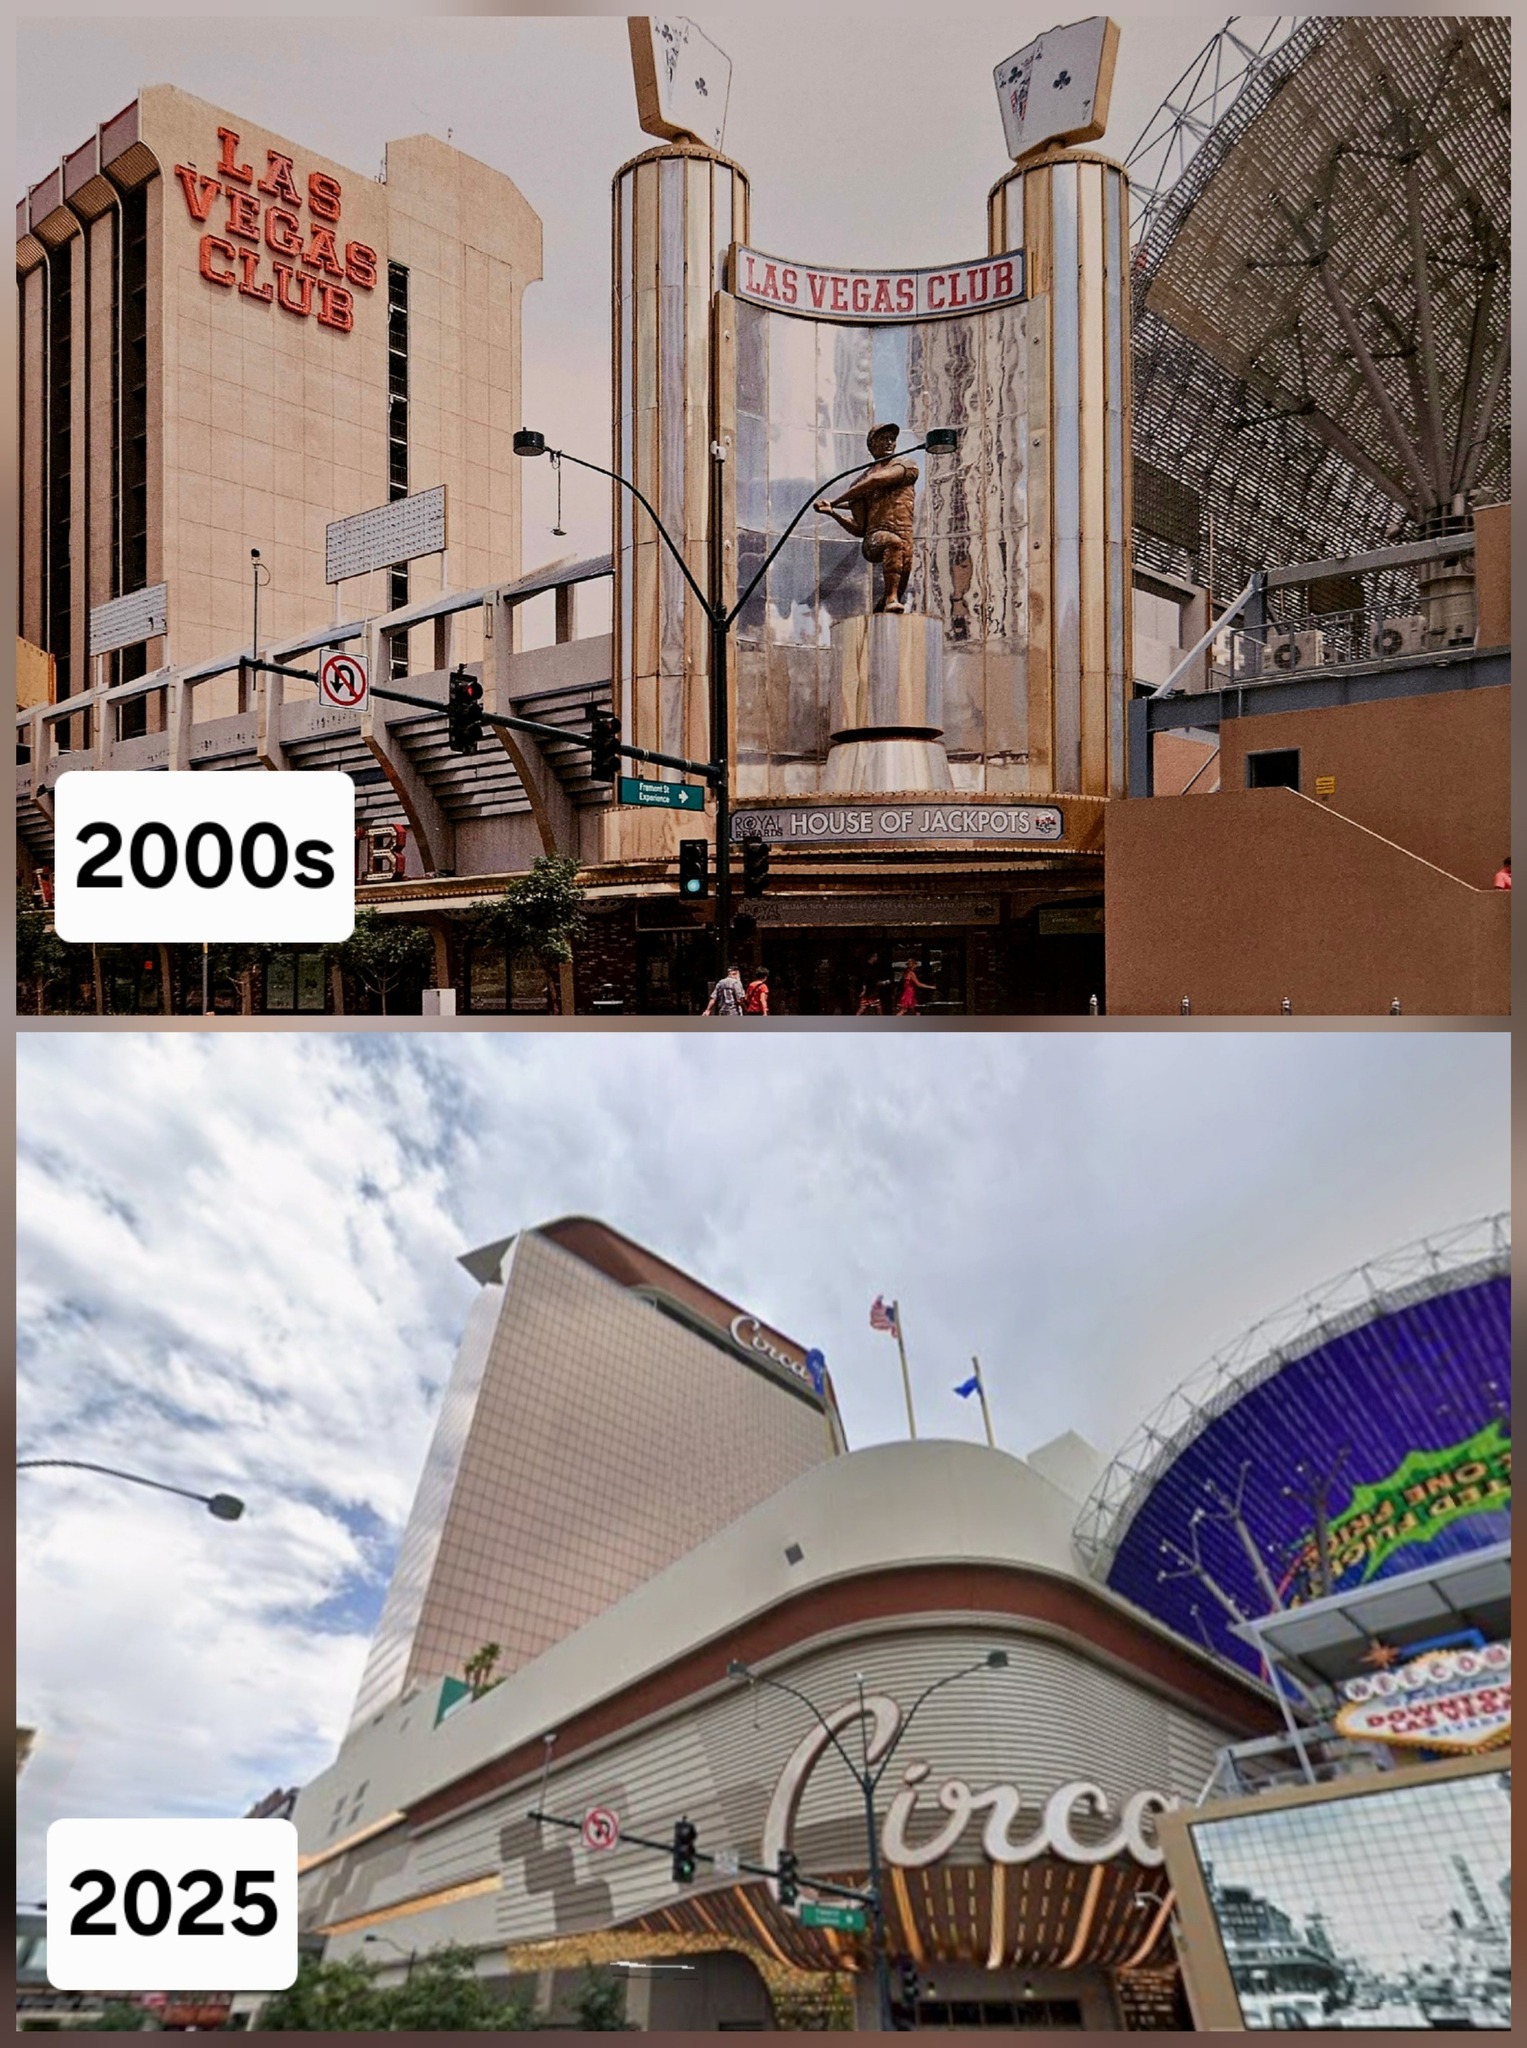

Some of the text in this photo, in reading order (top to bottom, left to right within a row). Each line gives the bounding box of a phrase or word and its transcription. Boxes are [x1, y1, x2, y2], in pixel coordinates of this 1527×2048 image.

[217, 126, 342, 222] LAS
[174, 163, 378, 290] VEGAS
[199, 234, 354, 333] CLUB
[746, 256, 1013, 313] LAS VEGAS CLUB
[639, 792, 671, 804] Experience
[734, 814, 783, 830] ROYAL
[789, 811, 873, 835] HOUSE
[879, 810, 914, 834] OF
[919, 810, 1031, 834] JACKPOTS
[735, 828, 783, 839] REWARDS
[1404, 1461, 1485, 1507] ONE
[1352, 1647, 1510, 1698] WELCOM
[762, 1693, 1178, 1913] Circa
